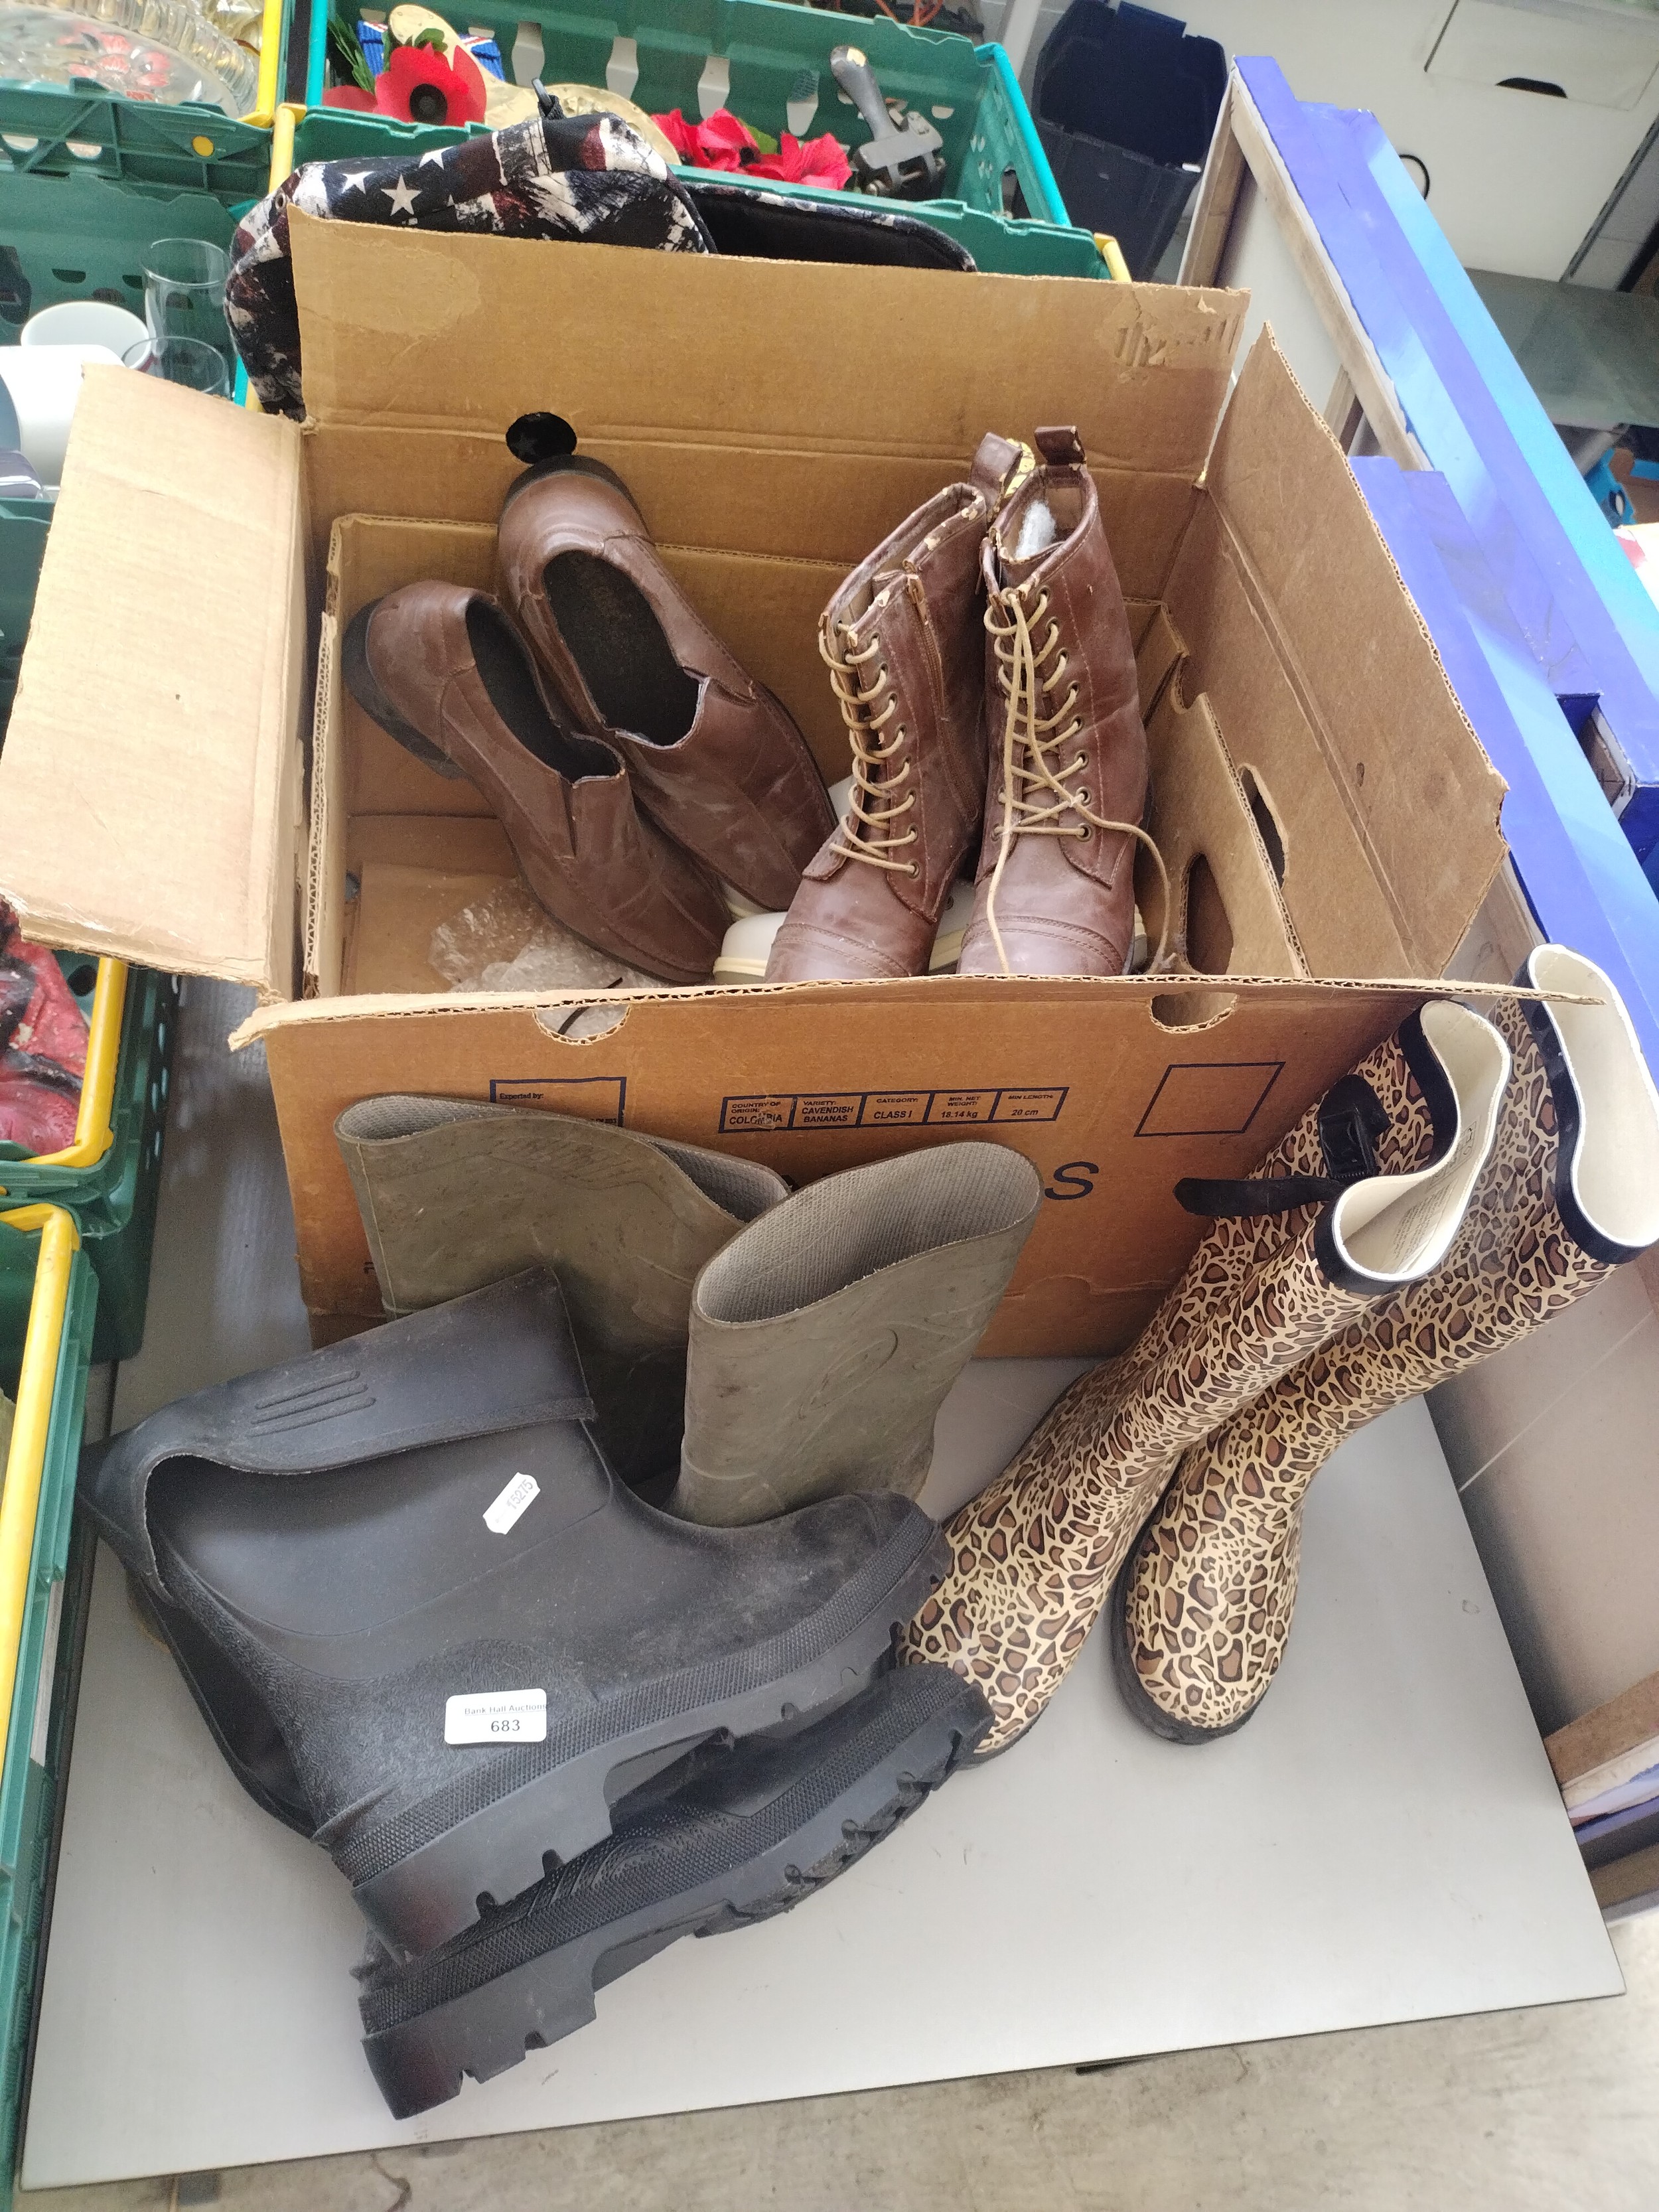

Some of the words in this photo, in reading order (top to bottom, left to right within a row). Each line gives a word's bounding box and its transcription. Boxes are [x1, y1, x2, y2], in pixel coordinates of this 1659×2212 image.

[802, 1106, 854, 1114] CAVENDISH
[966, 1110, 979, 1119] kg
[873, 1110, 906, 1120] CLASS
[506, 1479, 534, 1509] 15275
[489, 1705, 506, 1714] Hall
[490, 1719, 520, 1732] 683
